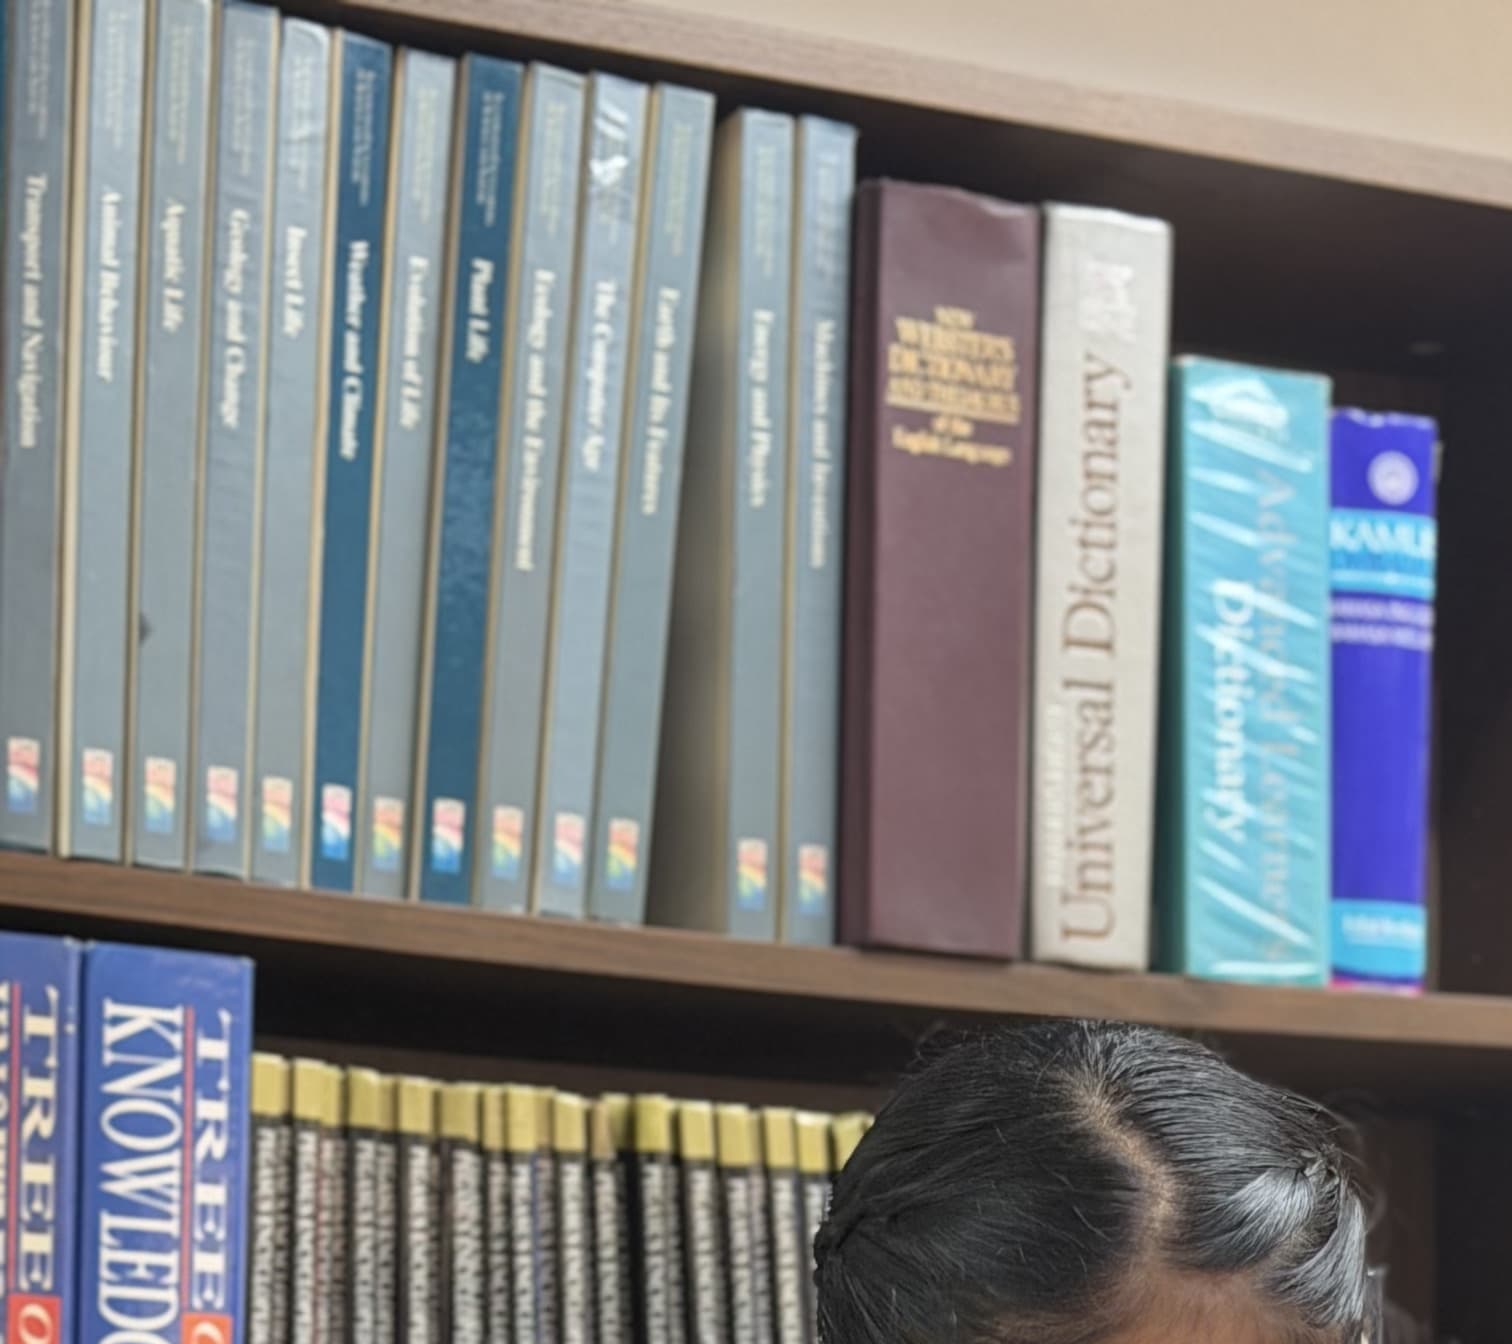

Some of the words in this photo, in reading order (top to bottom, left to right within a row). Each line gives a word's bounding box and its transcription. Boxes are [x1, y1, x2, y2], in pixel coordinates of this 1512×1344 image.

[20, 174, 49, 281] Transport
[100, 193, 122, 267] Animal
[160, 202, 186, 283] Aquatic
[223, 208, 250, 294] Geology
[285, 226, 308, 289] Insect
[22, 283, 43, 328] and
[162, 287, 185, 333] Life
[225, 300, 247, 342] and
[283, 294, 306, 338] Life
[345, 240, 370, 329] Weather
[403, 255, 430, 358] Evolution
[468, 257, 495, 316] Plant
[525, 268, 556, 349] Ecology
[594, 279, 617, 321] The
[654, 286, 681, 349] Earth
[343, 331, 364, 373] and
[401, 361, 424, 384] of
[465, 317, 491, 362] Life
[525, 352, 549, 397] and
[582, 322, 614, 428] Computer
[651, 350, 676, 392] and
[749, 308, 775, 383] Energy
[812, 318, 836, 414] Machines
[17, 331, 45, 448] Navigation
[220, 346, 247, 429] Change
[339, 375, 363, 461] Climate
[399, 384, 423, 429] Life
[524, 398, 549, 432] the
[752, 387, 773, 430] and
[582, 431, 606, 472] Age
[640, 426, 670, 516] Features
[749, 431, 772, 508] Physics
[812, 418, 834, 460] and
[515, 435, 545, 571] Environment
[1060, 352, 1132, 653] Dictionary
[1203, 580, 1257, 845] Dictionary
[1060, 677, 1117, 943] Universal
[19, 984, 60, 1293] TREE
[190, 1008, 232, 1312] TREE
